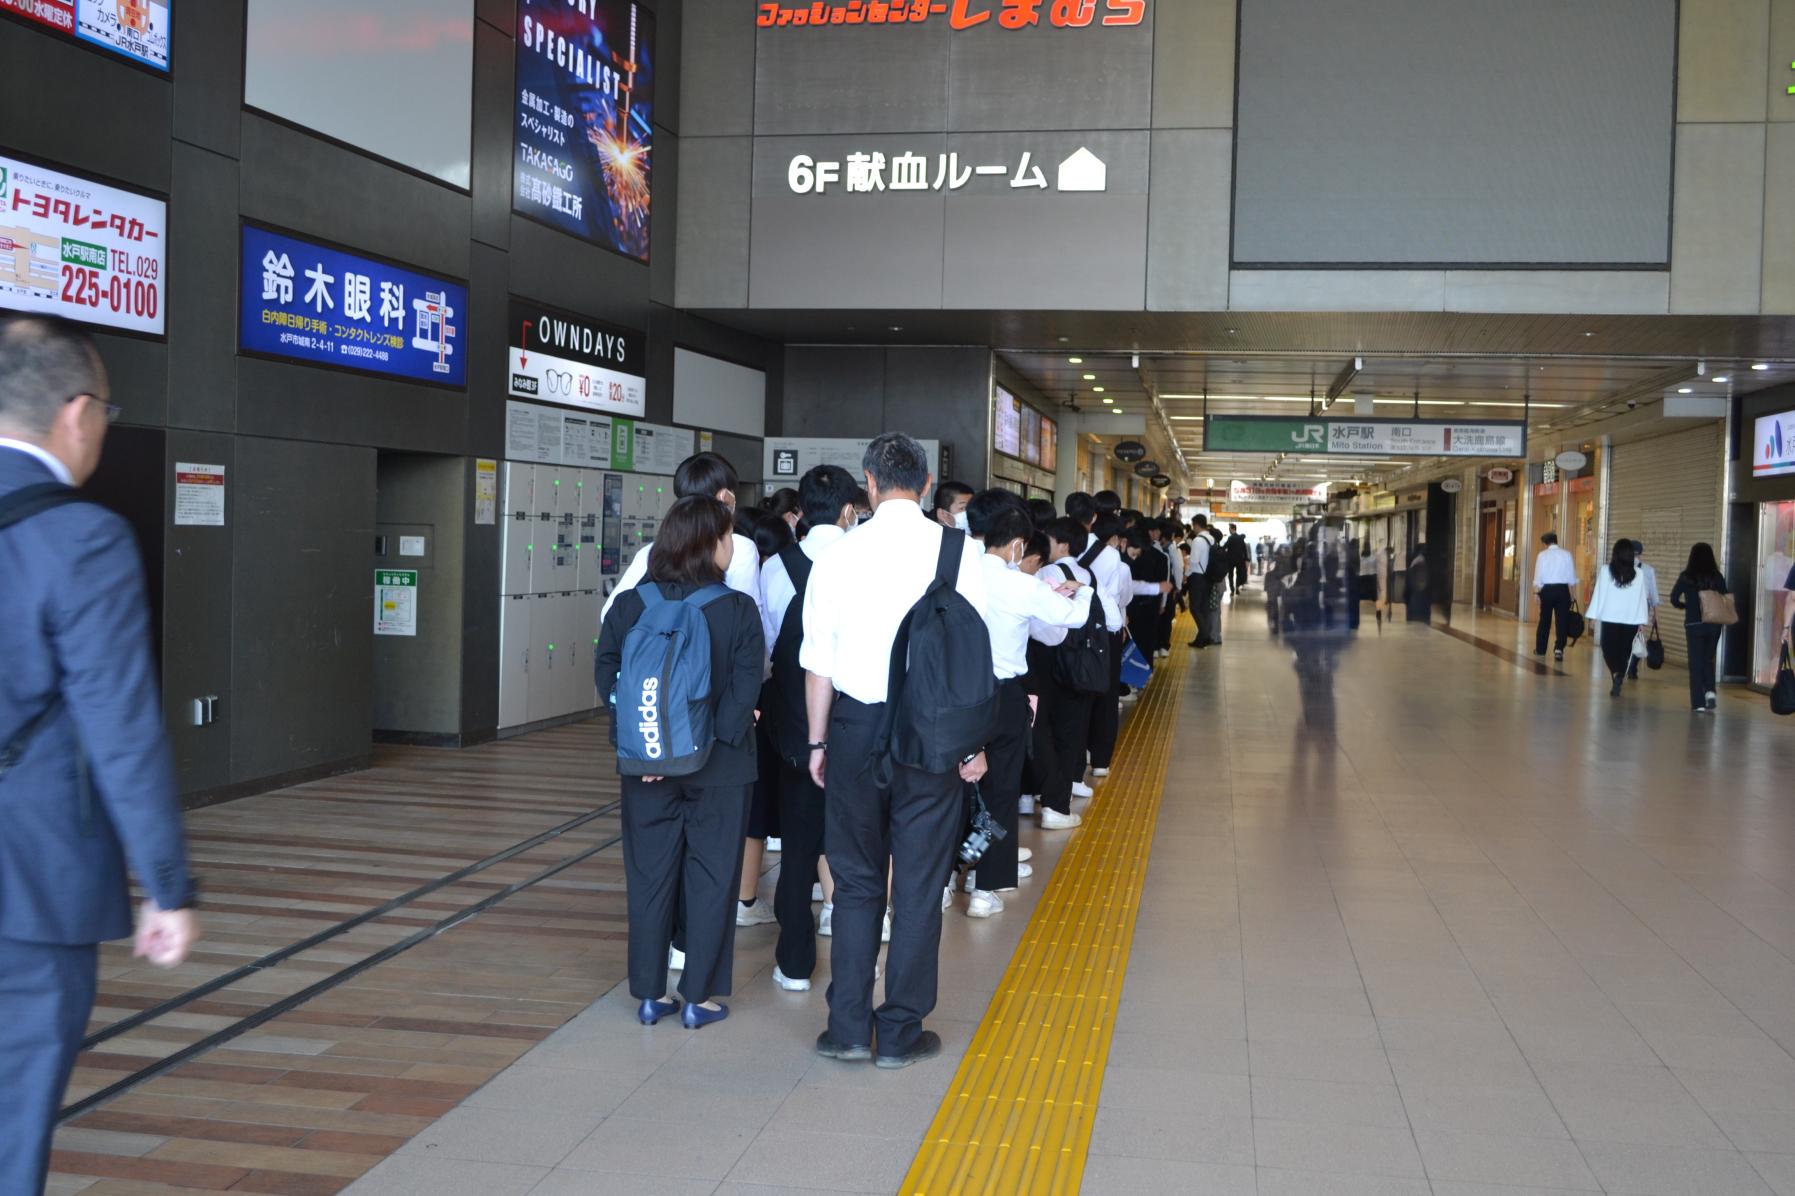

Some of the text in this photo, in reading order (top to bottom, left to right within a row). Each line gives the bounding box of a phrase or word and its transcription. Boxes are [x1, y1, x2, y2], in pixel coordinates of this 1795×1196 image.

[523, 15, 620, 100] SPECIALIST
[521, 113, 565, 147] スペシャリスト
[520, 142, 573, 181] TAKASAGO
[12, 188, 159, 242] トヨタレンタカー
[62, 241, 106, 267] 水戸駅南店
[110, 249, 158, 280] TEL.029
[61, 264, 158, 319] 225-0100
[262, 250, 406, 330] 鈴木眼科
[539, 316, 625, 362] OWNDAYS
[1291, 425, 1324, 442] JR
[1331, 441, 1350, 450] Mito
[1352, 441, 1384, 450] Station
[1332, 426, 1375, 440] 水戸駅
[1391, 427, 1412, 437] 南口
[638, 677, 662, 759] adidas
